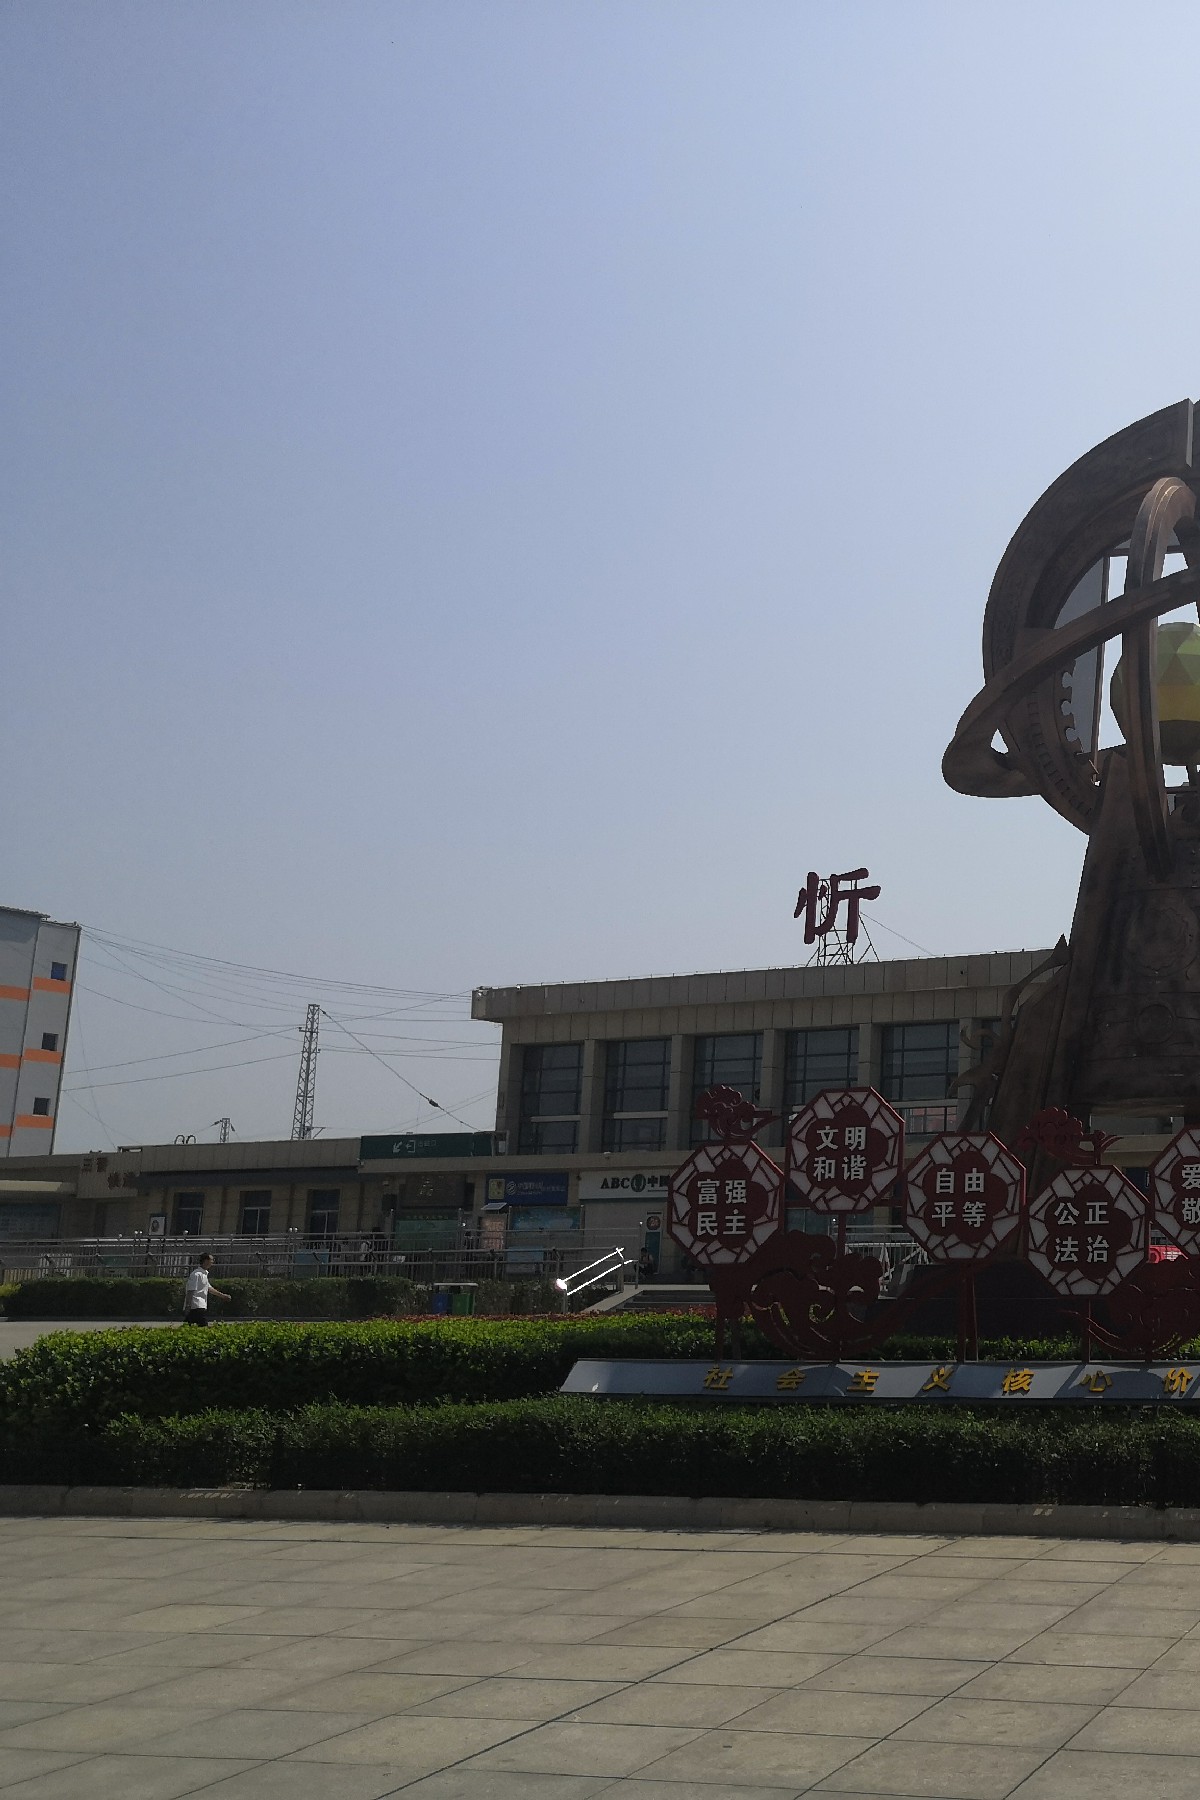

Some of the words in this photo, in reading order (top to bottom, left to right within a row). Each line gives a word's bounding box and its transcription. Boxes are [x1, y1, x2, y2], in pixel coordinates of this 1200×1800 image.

[794, 868, 881, 944] 忻
[816, 1126, 868, 1151] 文明
[600, 1177, 630, 1189] ABC
[813, 1157, 868, 1182] 和谐
[935, 1167, 985, 1194] 自由
[697, 1178, 748, 1205] 富强
[696, 1209, 748, 1236] 民主
[931, 1201, 987, 1228] 平等
[1053, 1201, 1110, 1226] 公正
[1053, 1234, 1110, 1263] 法治
